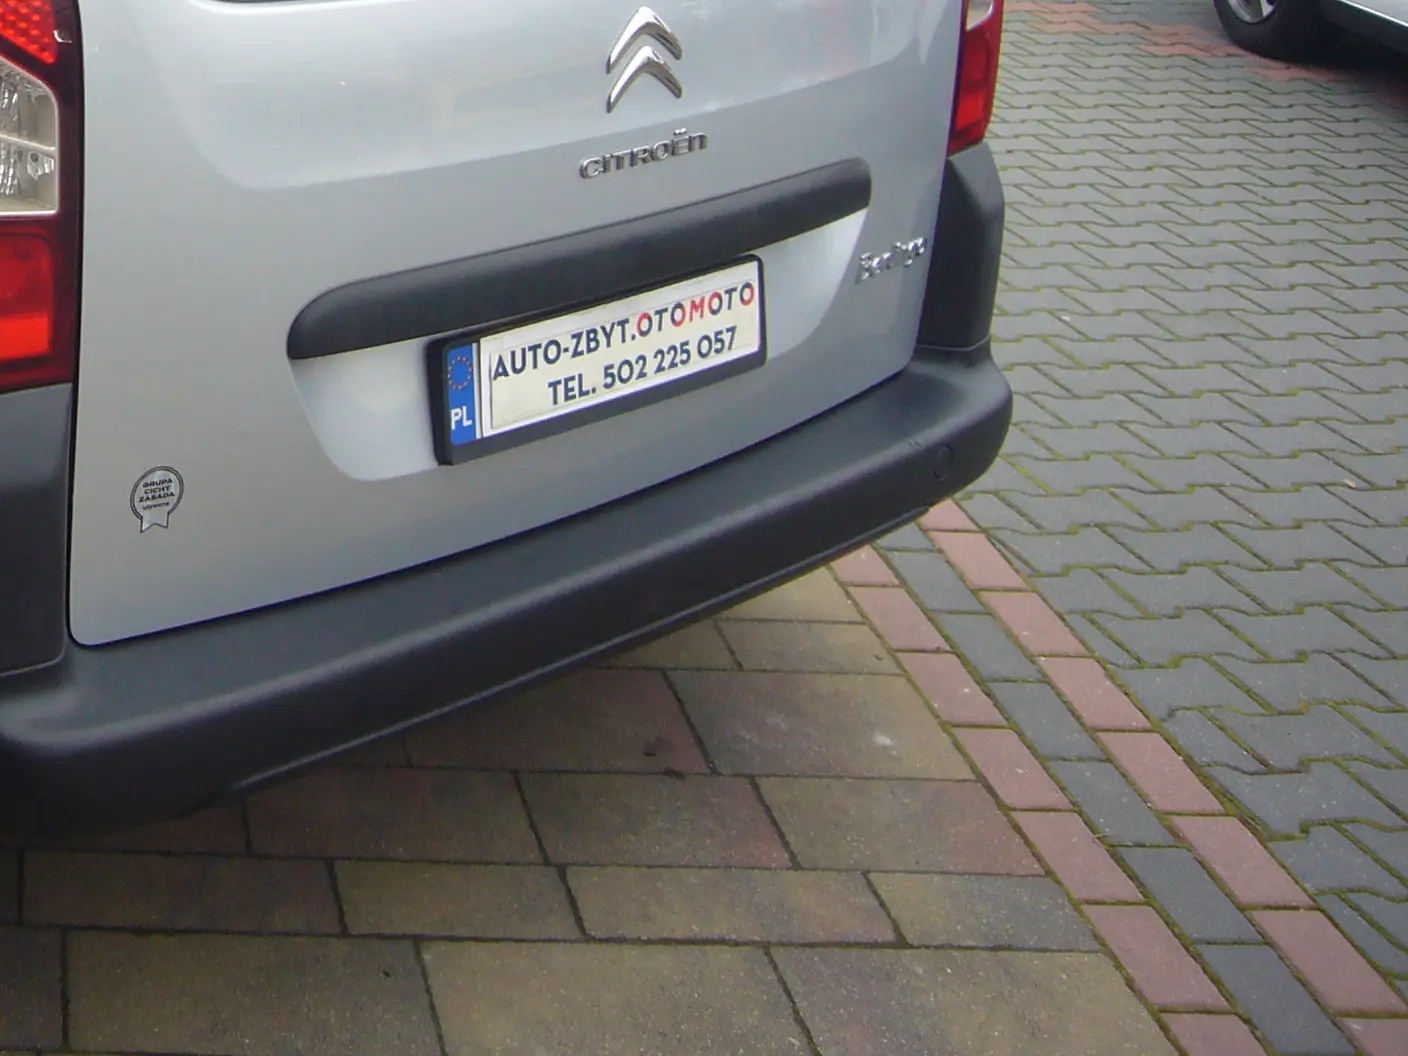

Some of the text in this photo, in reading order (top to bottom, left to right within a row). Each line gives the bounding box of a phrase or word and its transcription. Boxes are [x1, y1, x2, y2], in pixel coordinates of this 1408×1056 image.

[492, 281, 755, 381] AUTO-ZBYT.OTOMOTO
[548, 325, 737, 405] TEL. 502 225 057
[450, 406, 473, 430] PL
[143, 478, 172, 488] GRUPA
[144, 485, 171, 494] CICHY
[139, 492, 174, 502] ZASADA
